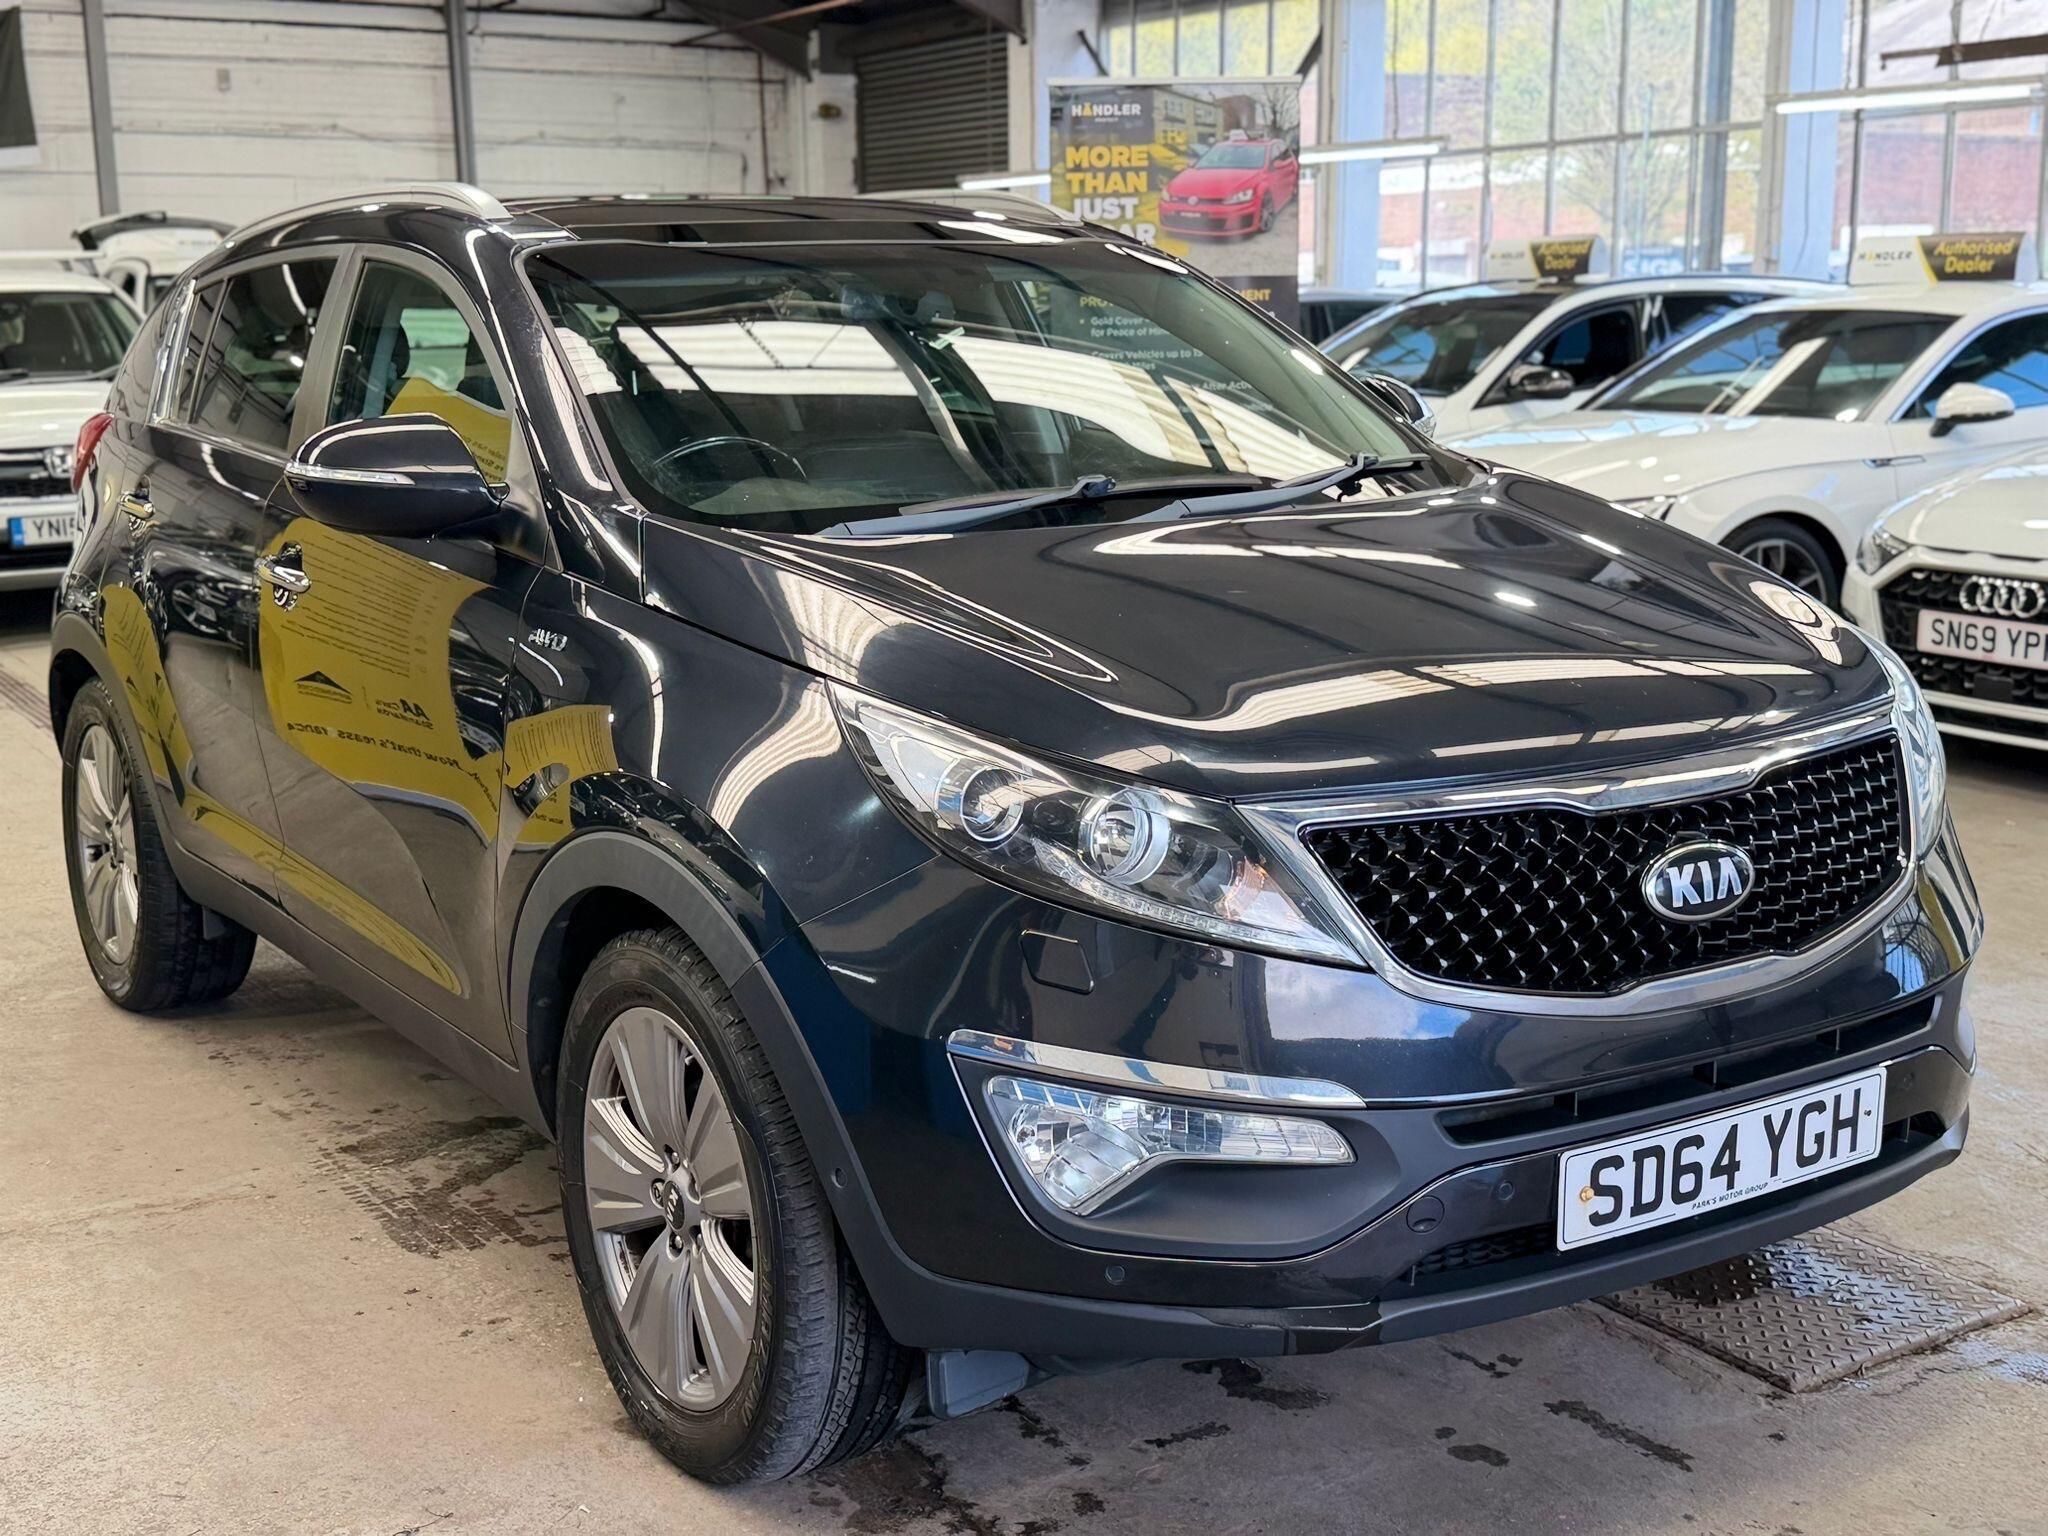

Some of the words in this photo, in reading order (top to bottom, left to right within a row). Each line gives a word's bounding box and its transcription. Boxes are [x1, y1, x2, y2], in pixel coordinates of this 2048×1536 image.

[1071, 101, 1141, 117] HANDLER
[1066, 145, 1149, 168] MORE
[1066, 171, 1148, 194] THAN
[1072, 197, 1139, 221] JUST
[1114, 222, 1156, 248] AR
[1859, 250, 1913, 263] HANDLER
[1934, 238, 2017, 256] Authorised
[1545, 255, 1578, 271] Dealer
[1944, 256, 1995, 273] Dealer
[1080, 296, 1114, 308] PRO
[1091, 316, 1114, 326] Gold
[1115, 316, 1144, 326] Cover
[1091, 327, 1105, 338] for
[1106, 327, 1135, 337] Peace
[1136, 327, 1147, 337] of
[1148, 327, 1171, 336] Min
[1125, 349, 1164, 360] Vehicles
[1166, 350, 1179, 360] up
[1180, 349, 1192, 358] to
[528, 628, 568, 652] AWD
[1931, 618, 1997, 653] SN69
[1666, 856, 1743, 908] KIA
[1588, 1123, 1741, 1227] SD64
[1763, 1087, 1861, 1179] YGH
[667, 1188, 679, 1222] KIA
[1691, 1196, 1718, 1210] PARK'S
[1718, 1189, 1744, 1203] MOTOR
[1744, 1182, 1769, 1196] GROUP
